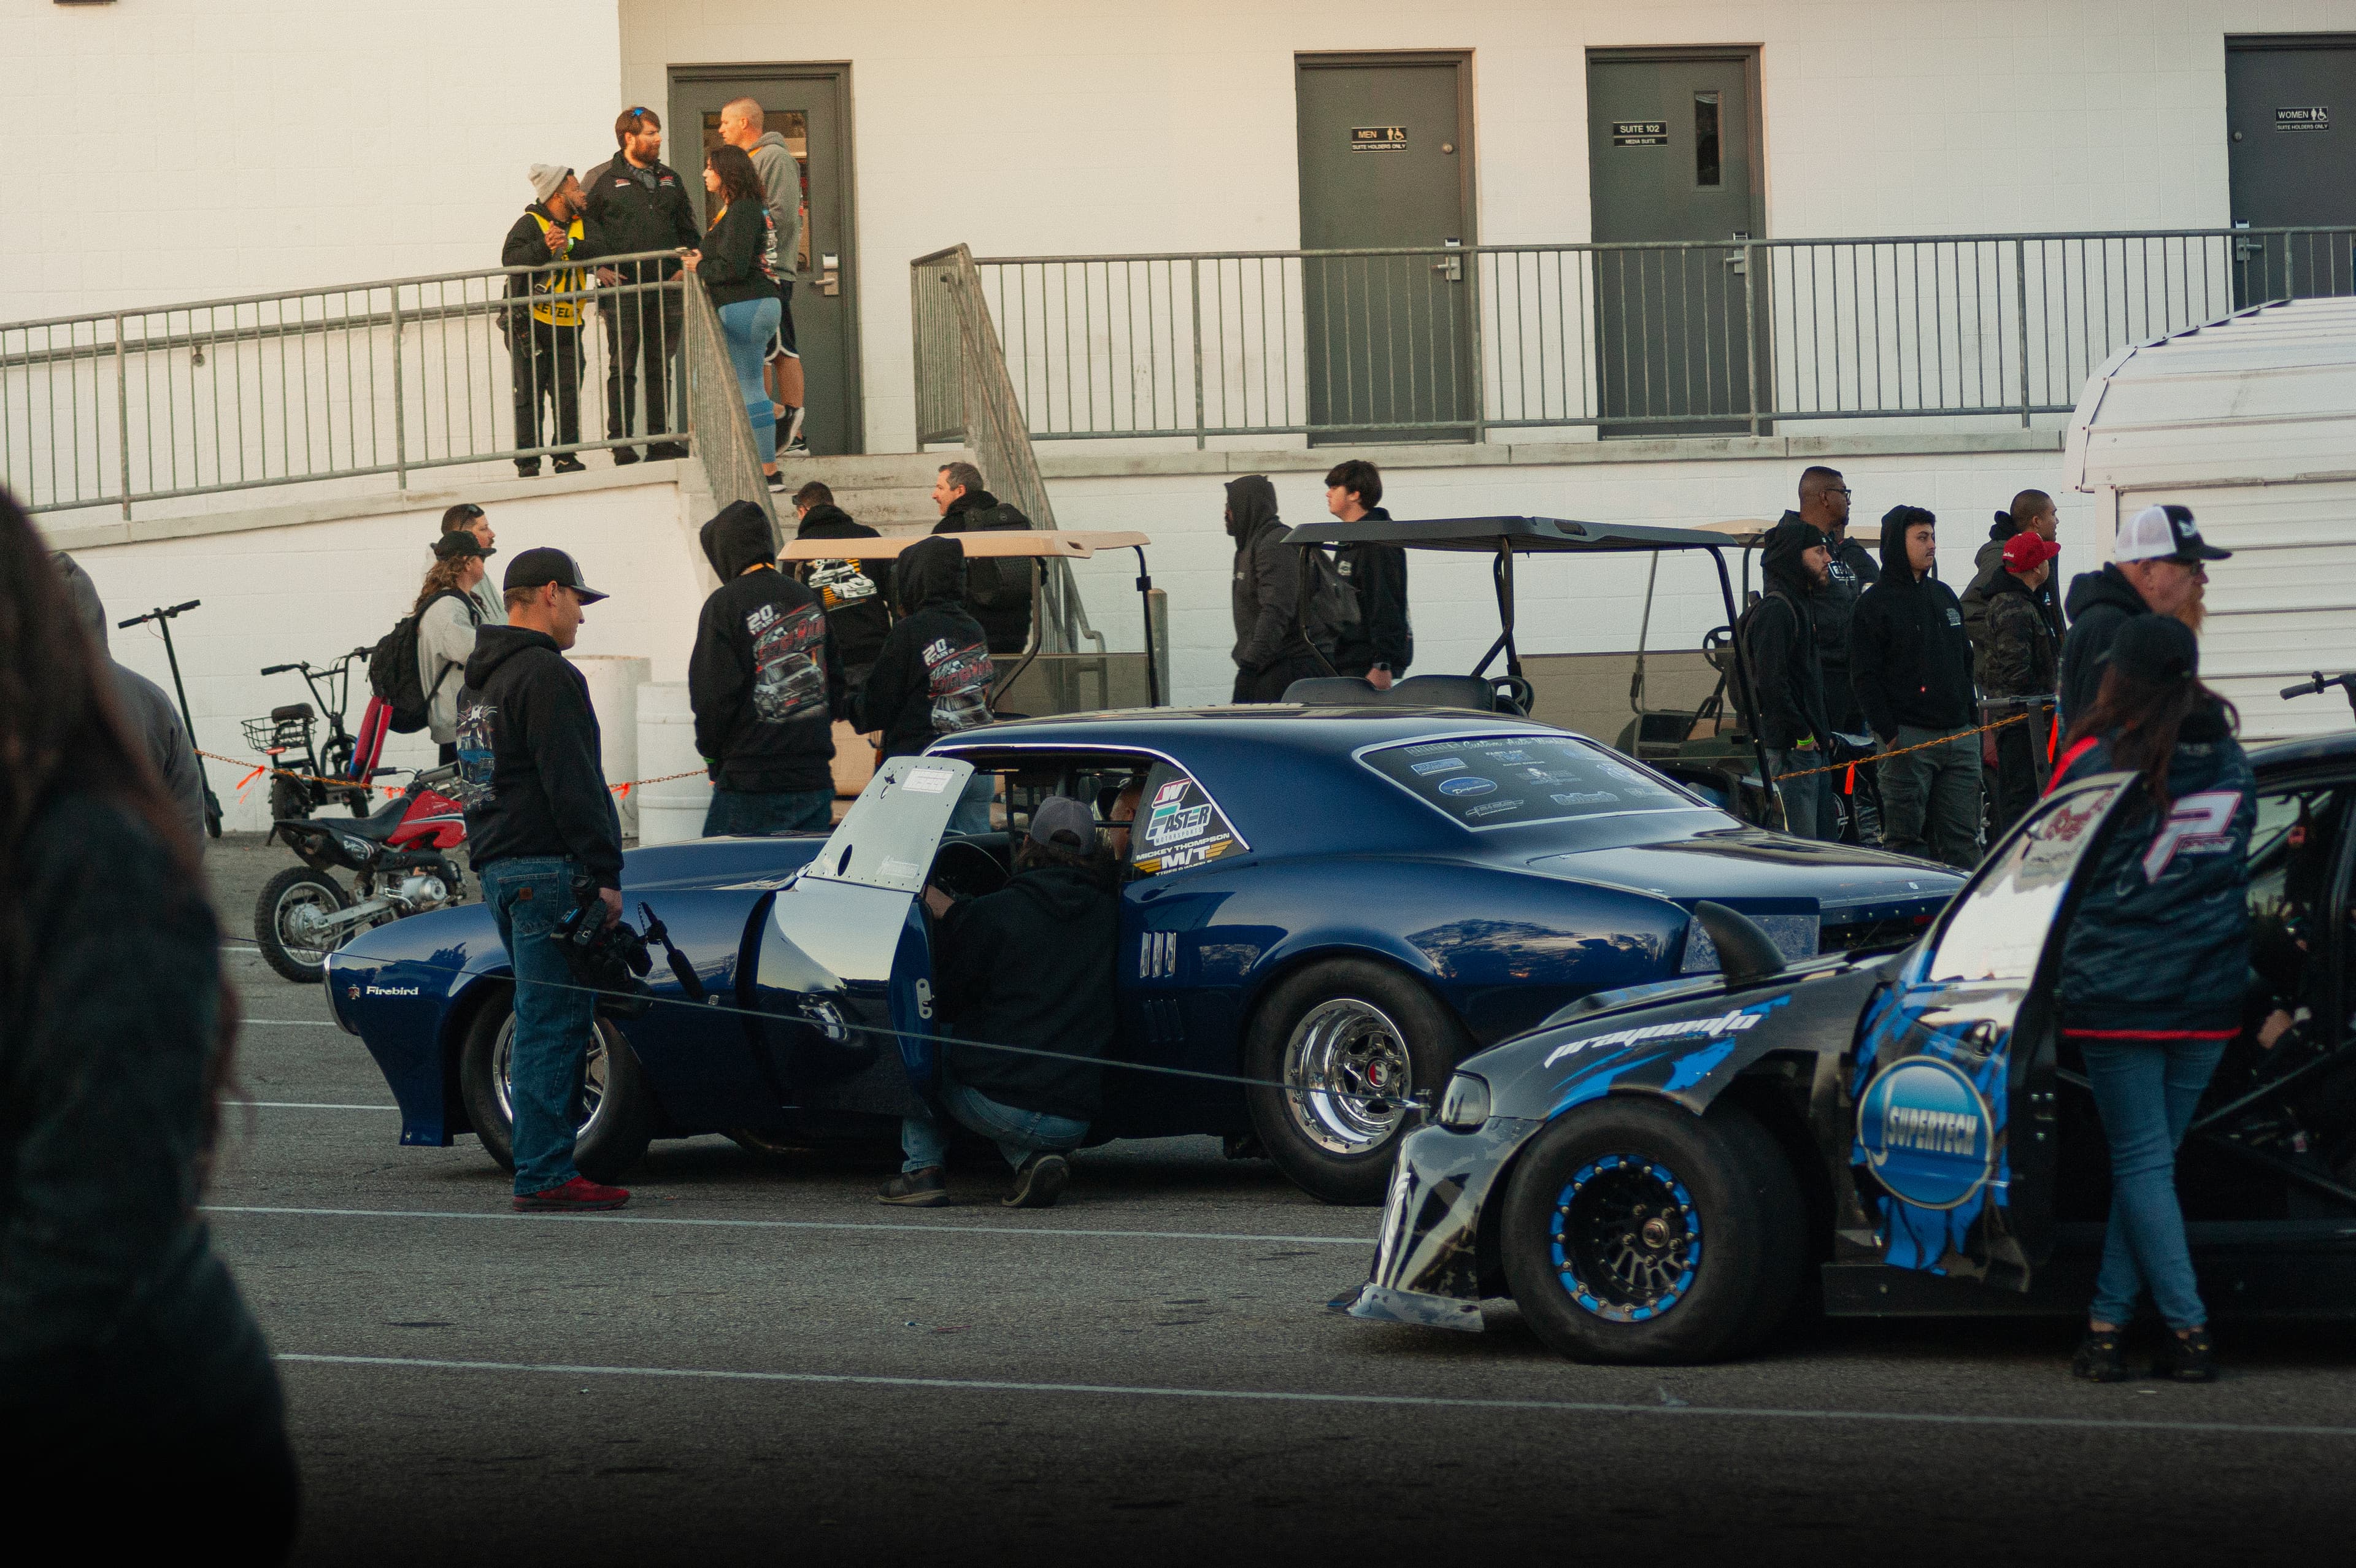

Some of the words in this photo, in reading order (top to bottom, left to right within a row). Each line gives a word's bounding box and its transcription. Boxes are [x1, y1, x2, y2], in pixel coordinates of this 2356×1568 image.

[747, 604, 773, 632] 20
[923, 639, 947, 665] 20
[1463, 740, 1503, 749] Custom
[1148, 805, 1210, 837] FASTER
[1136, 847, 1173, 860] MICKEY
[1174, 832, 1230, 851] THOMPSON
[1156, 828, 1203, 844] MOTORSPORTS
[1161, 845, 1211, 869] M/T
[366, 986, 418, 996] Firebird
[1887, 1105, 1979, 1156] SUPERTECH
